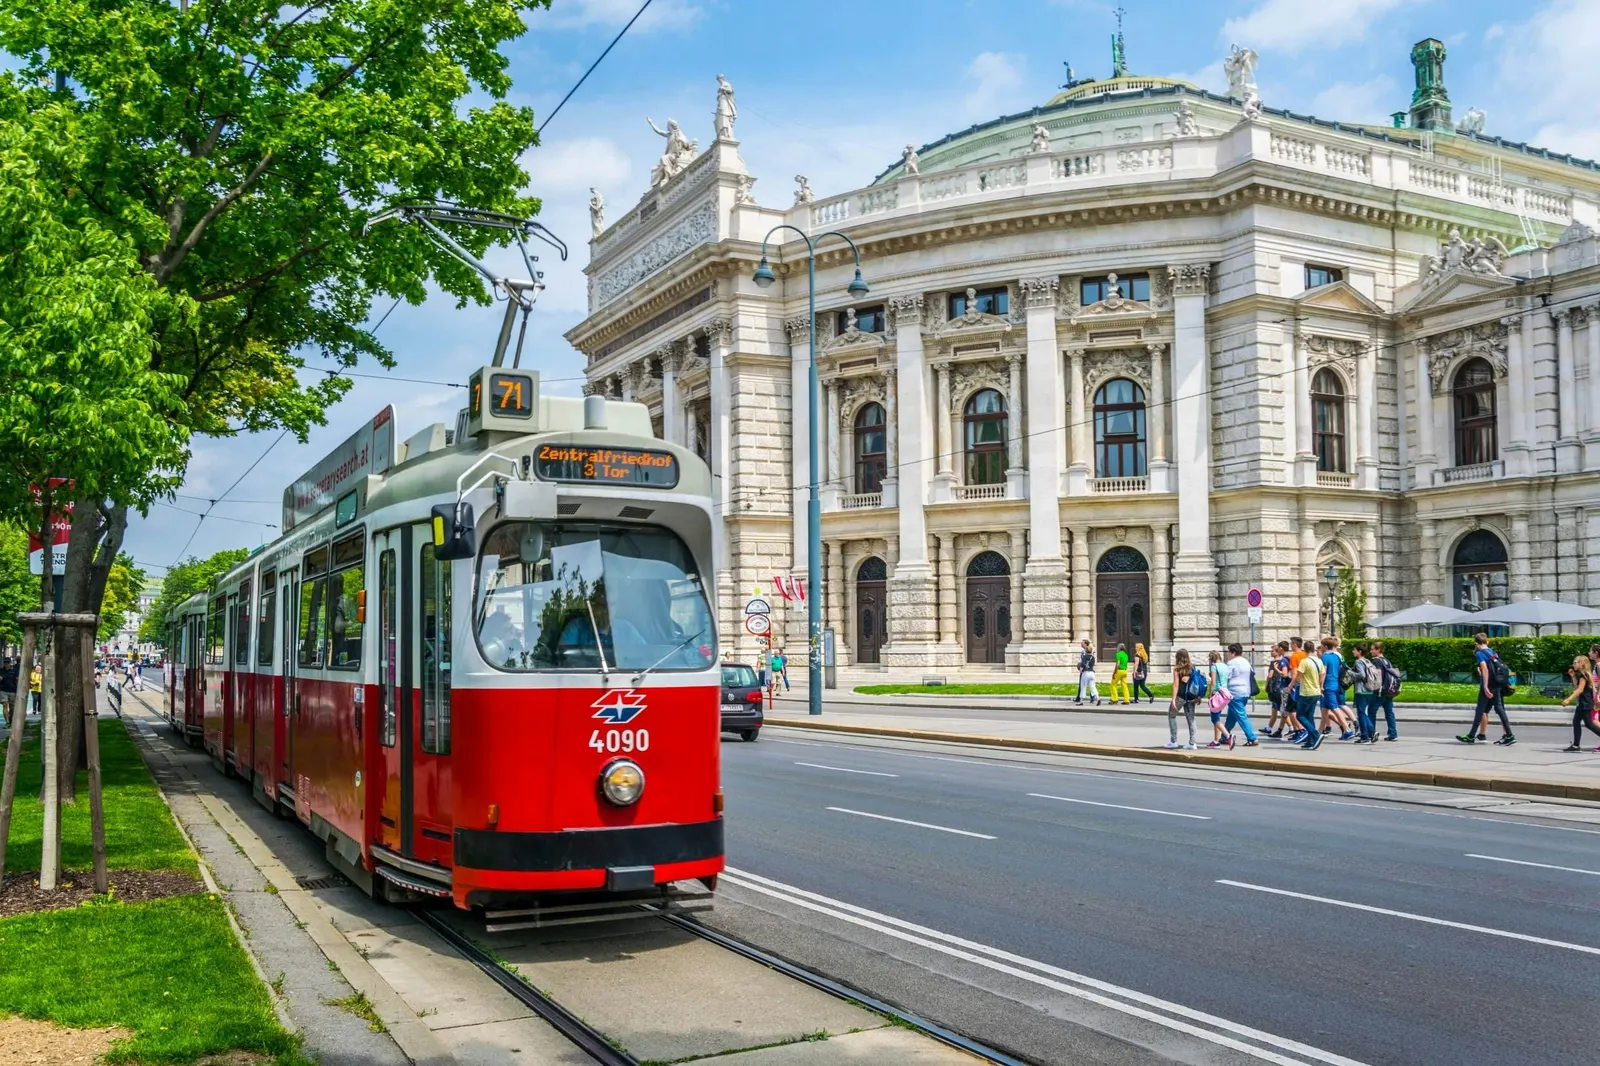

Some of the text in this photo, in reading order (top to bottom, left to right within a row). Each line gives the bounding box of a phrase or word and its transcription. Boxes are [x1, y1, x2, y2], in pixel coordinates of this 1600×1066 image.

[497, 380, 523, 410] 71
[539, 446, 673, 468] Zentralfriedhof
[584, 464, 630, 478] 3. Tor
[588, 729, 650, 753] 4090
